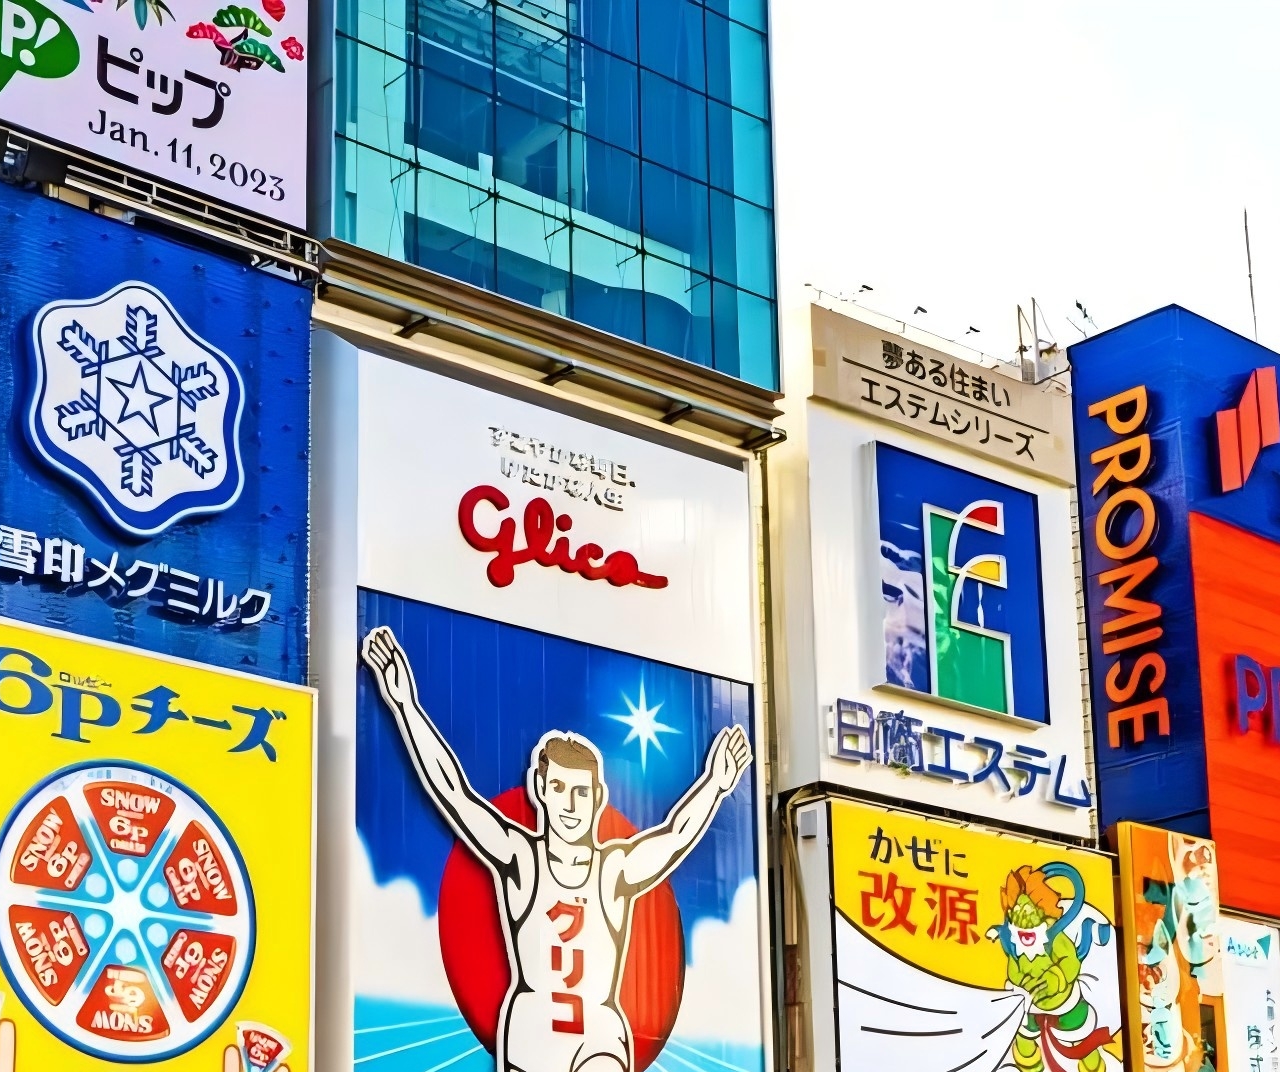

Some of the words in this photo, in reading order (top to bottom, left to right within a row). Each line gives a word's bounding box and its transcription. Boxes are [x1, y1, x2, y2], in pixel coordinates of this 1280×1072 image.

[95, 34, 231, 129] ピップ
[88, 109, 157, 156] Jan.
[167, 138, 201, 176] 11,
[209, 152, 286, 202] 2023
[881, 339, 1010, 406] 夢ある住まい
[861, 377, 1034, 461] エステムシリーズ
[458, 485, 668, 588] Glico
[1088, 385, 1170, 749] PROMISE
[101, 788, 161, 814] SNOW
[20, 807, 64, 871] SNOW
[193, 839, 232, 901] SNOW
[868, 826, 969, 878] かぜに
[858, 869, 980, 945] 改源
[15, 921, 58, 987] SNOW
[189, 947, 228, 1010] SNOW
[546, 897, 587, 1034] グリコ
[91, 1011, 153, 1034] SNOW
